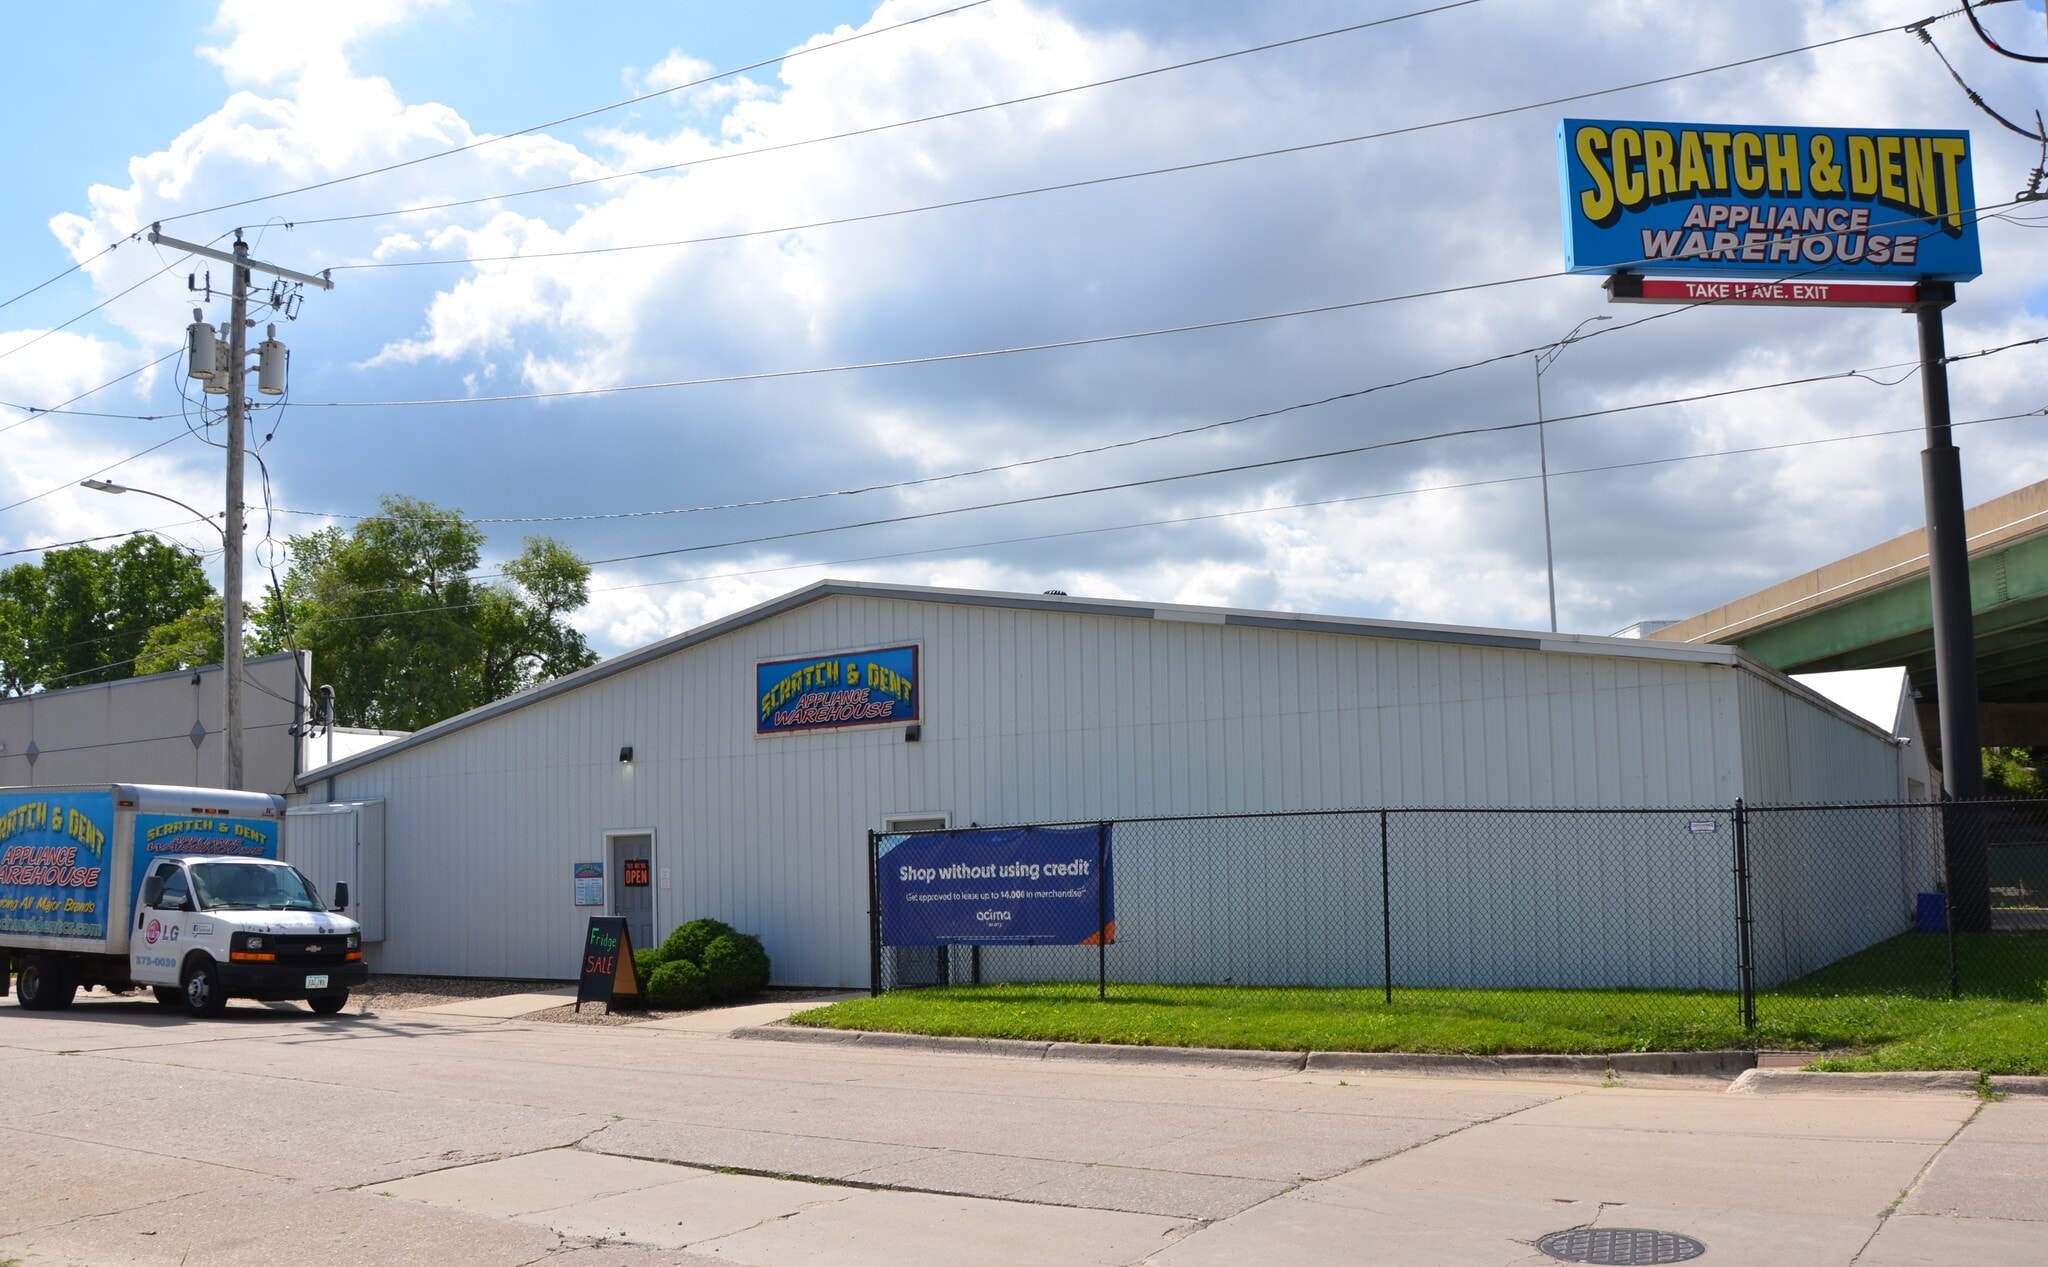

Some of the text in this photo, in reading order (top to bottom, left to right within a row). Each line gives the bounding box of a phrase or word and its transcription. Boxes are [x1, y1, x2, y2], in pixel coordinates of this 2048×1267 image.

[1574, 125, 1966, 233] SCRATCH & DENT
[1684, 204, 1870, 232] APPLIANCE
[1641, 228, 1919, 265] WAREHOUSE
[1686, 284, 1829, 299] TAKE H AVE. EXIT
[762, 660, 912, 722] SCRATCH & DENT
[796, 688, 870, 709] APPLIANCE
[774, 701, 895, 726] WAREHOUSE
[52, 806, 63, 832] &
[69, 808, 105, 859] DENT
[147, 819, 267, 845] SCRATCH & DENT
[172, 836, 243, 847] APPLIANCE
[1, 846, 77, 866] APPLIANCE
[146, 841, 266, 855] WAREHOUSE
[626, 870, 647, 884] OPEN
[900, 865, 936, 884] Shop
[939, 863, 996, 880] without
[999, 862, 1040, 880] using
[20, 896, 35, 910] All
[36, 896, 62, 913] Major
[64, 897, 95, 913] Brands
[906, 893, 918, 902] Get
[919, 892, 952, 902] approved
[953, 892, 961, 900] to
[962, 892, 979, 900] lease
[980, 892, 990, 901] up
[991, 892, 999, 900] to
[1026, 889, 1033, 898] in
[976, 908, 1012, 921] acima
[162, 925, 179, 941] LG
[590, 927, 617, 952] Fridge
[585, 955, 614, 975] SALE
